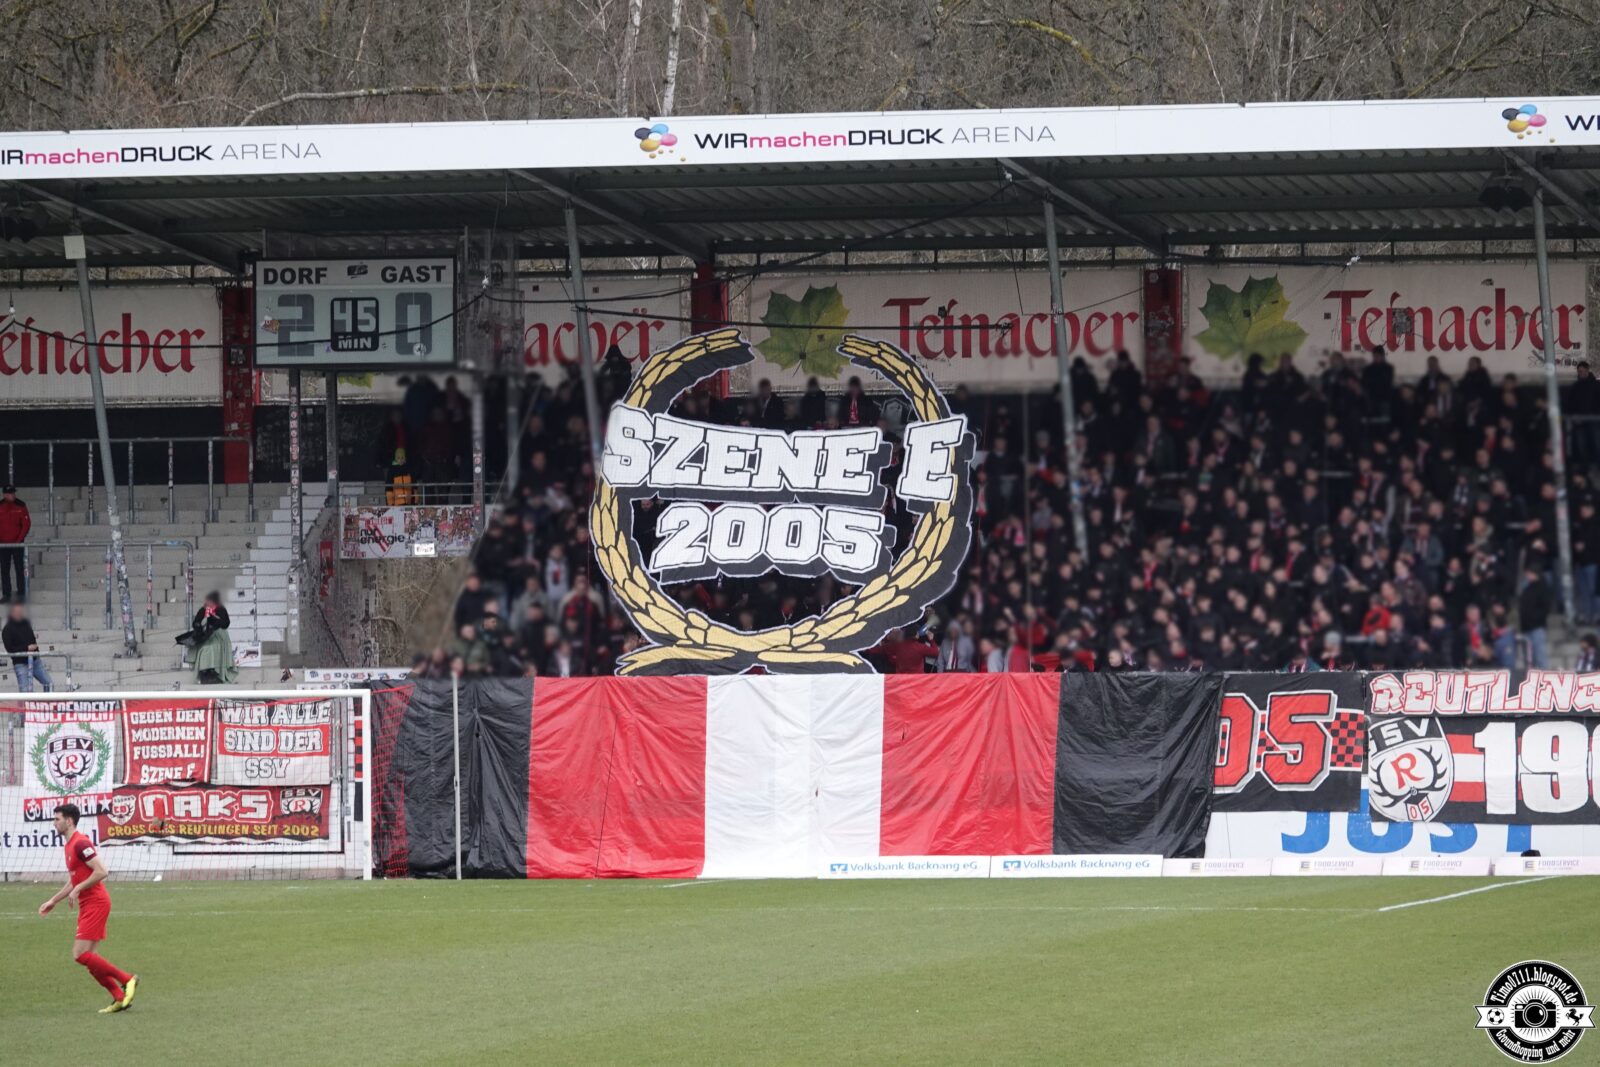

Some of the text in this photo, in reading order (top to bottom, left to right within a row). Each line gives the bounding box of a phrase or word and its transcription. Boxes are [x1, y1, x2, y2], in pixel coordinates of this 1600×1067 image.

[694, 126, 1056, 149] WIRmachenDRUCK ARENA
[221, 142, 321, 160] ARENA
[263, 267, 328, 285] DORF
[380, 265, 446, 283] GAST
[278, 292, 432, 356] 2 45 0
[0, 313, 205, 376] einacher
[338, 336, 372, 349] MIN
[602, 401, 968, 501] SZENE E
[649, 502, 885, 576] 2005
[25, 701, 115, 722] INDEPENDENT
[130, 708, 206, 724] GEGEN DEN
[221, 701, 333, 725] WIR ALLE
[132, 727, 206, 742] MODERNEN
[223, 728, 324, 753] SIND DER
[244, 757, 290, 779] SSV
[1474, 720, 1600, 816] 19
[18, 829, 64, 847] nich
[107, 823, 146, 837] CROSS
[252, 824, 279, 836] SEIT
[282, 825, 320, 837] 2002
[850, 861, 904, 872] Volksbank
[908, 861, 960, 872] Backnang
[1023, 859, 1077, 869] Volksbank
[1080, 860, 1132, 869] Backnang
